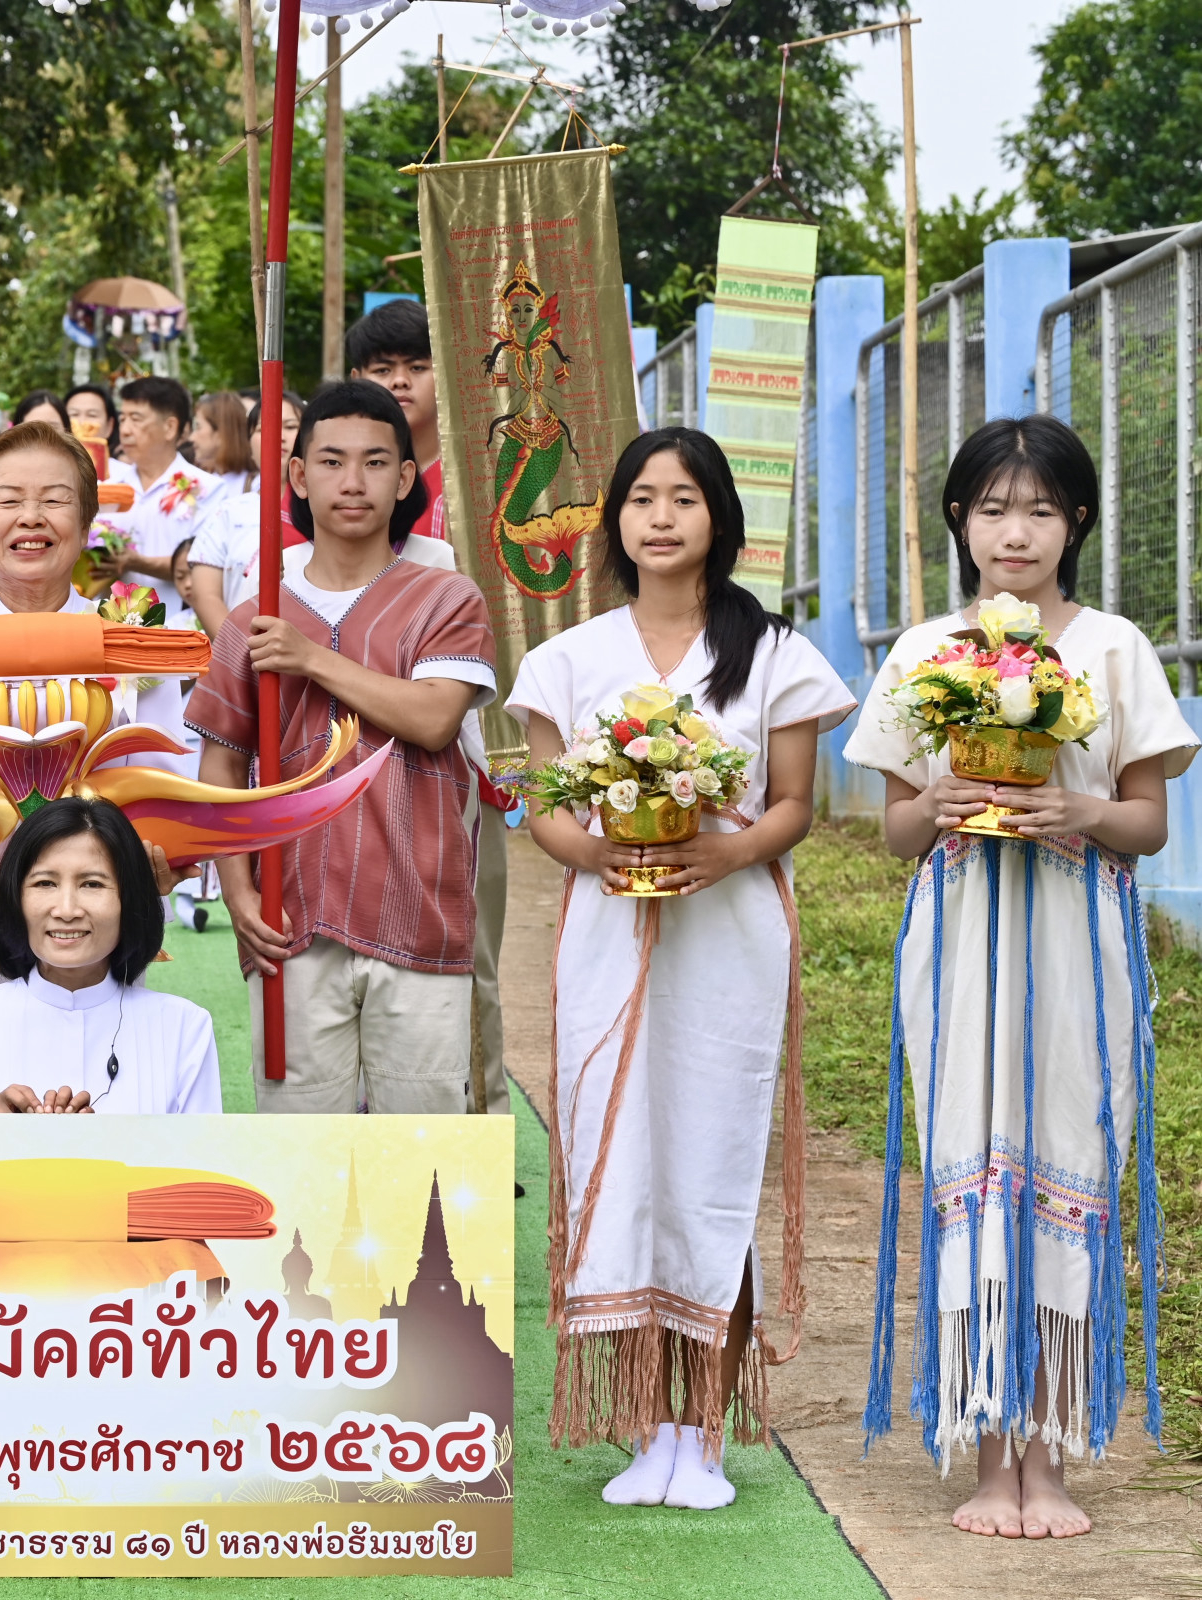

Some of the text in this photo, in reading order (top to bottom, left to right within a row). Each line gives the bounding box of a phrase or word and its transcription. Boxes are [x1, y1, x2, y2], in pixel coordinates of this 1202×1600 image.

[266, 1420, 486, 1473] ๒๕๖๘
[126, 1533, 172, 1556] ๘๑
[185, 1523, 205, 1555] ปี
[220, 1523, 474, 1556] หลวงพ่อธัมมชโย
